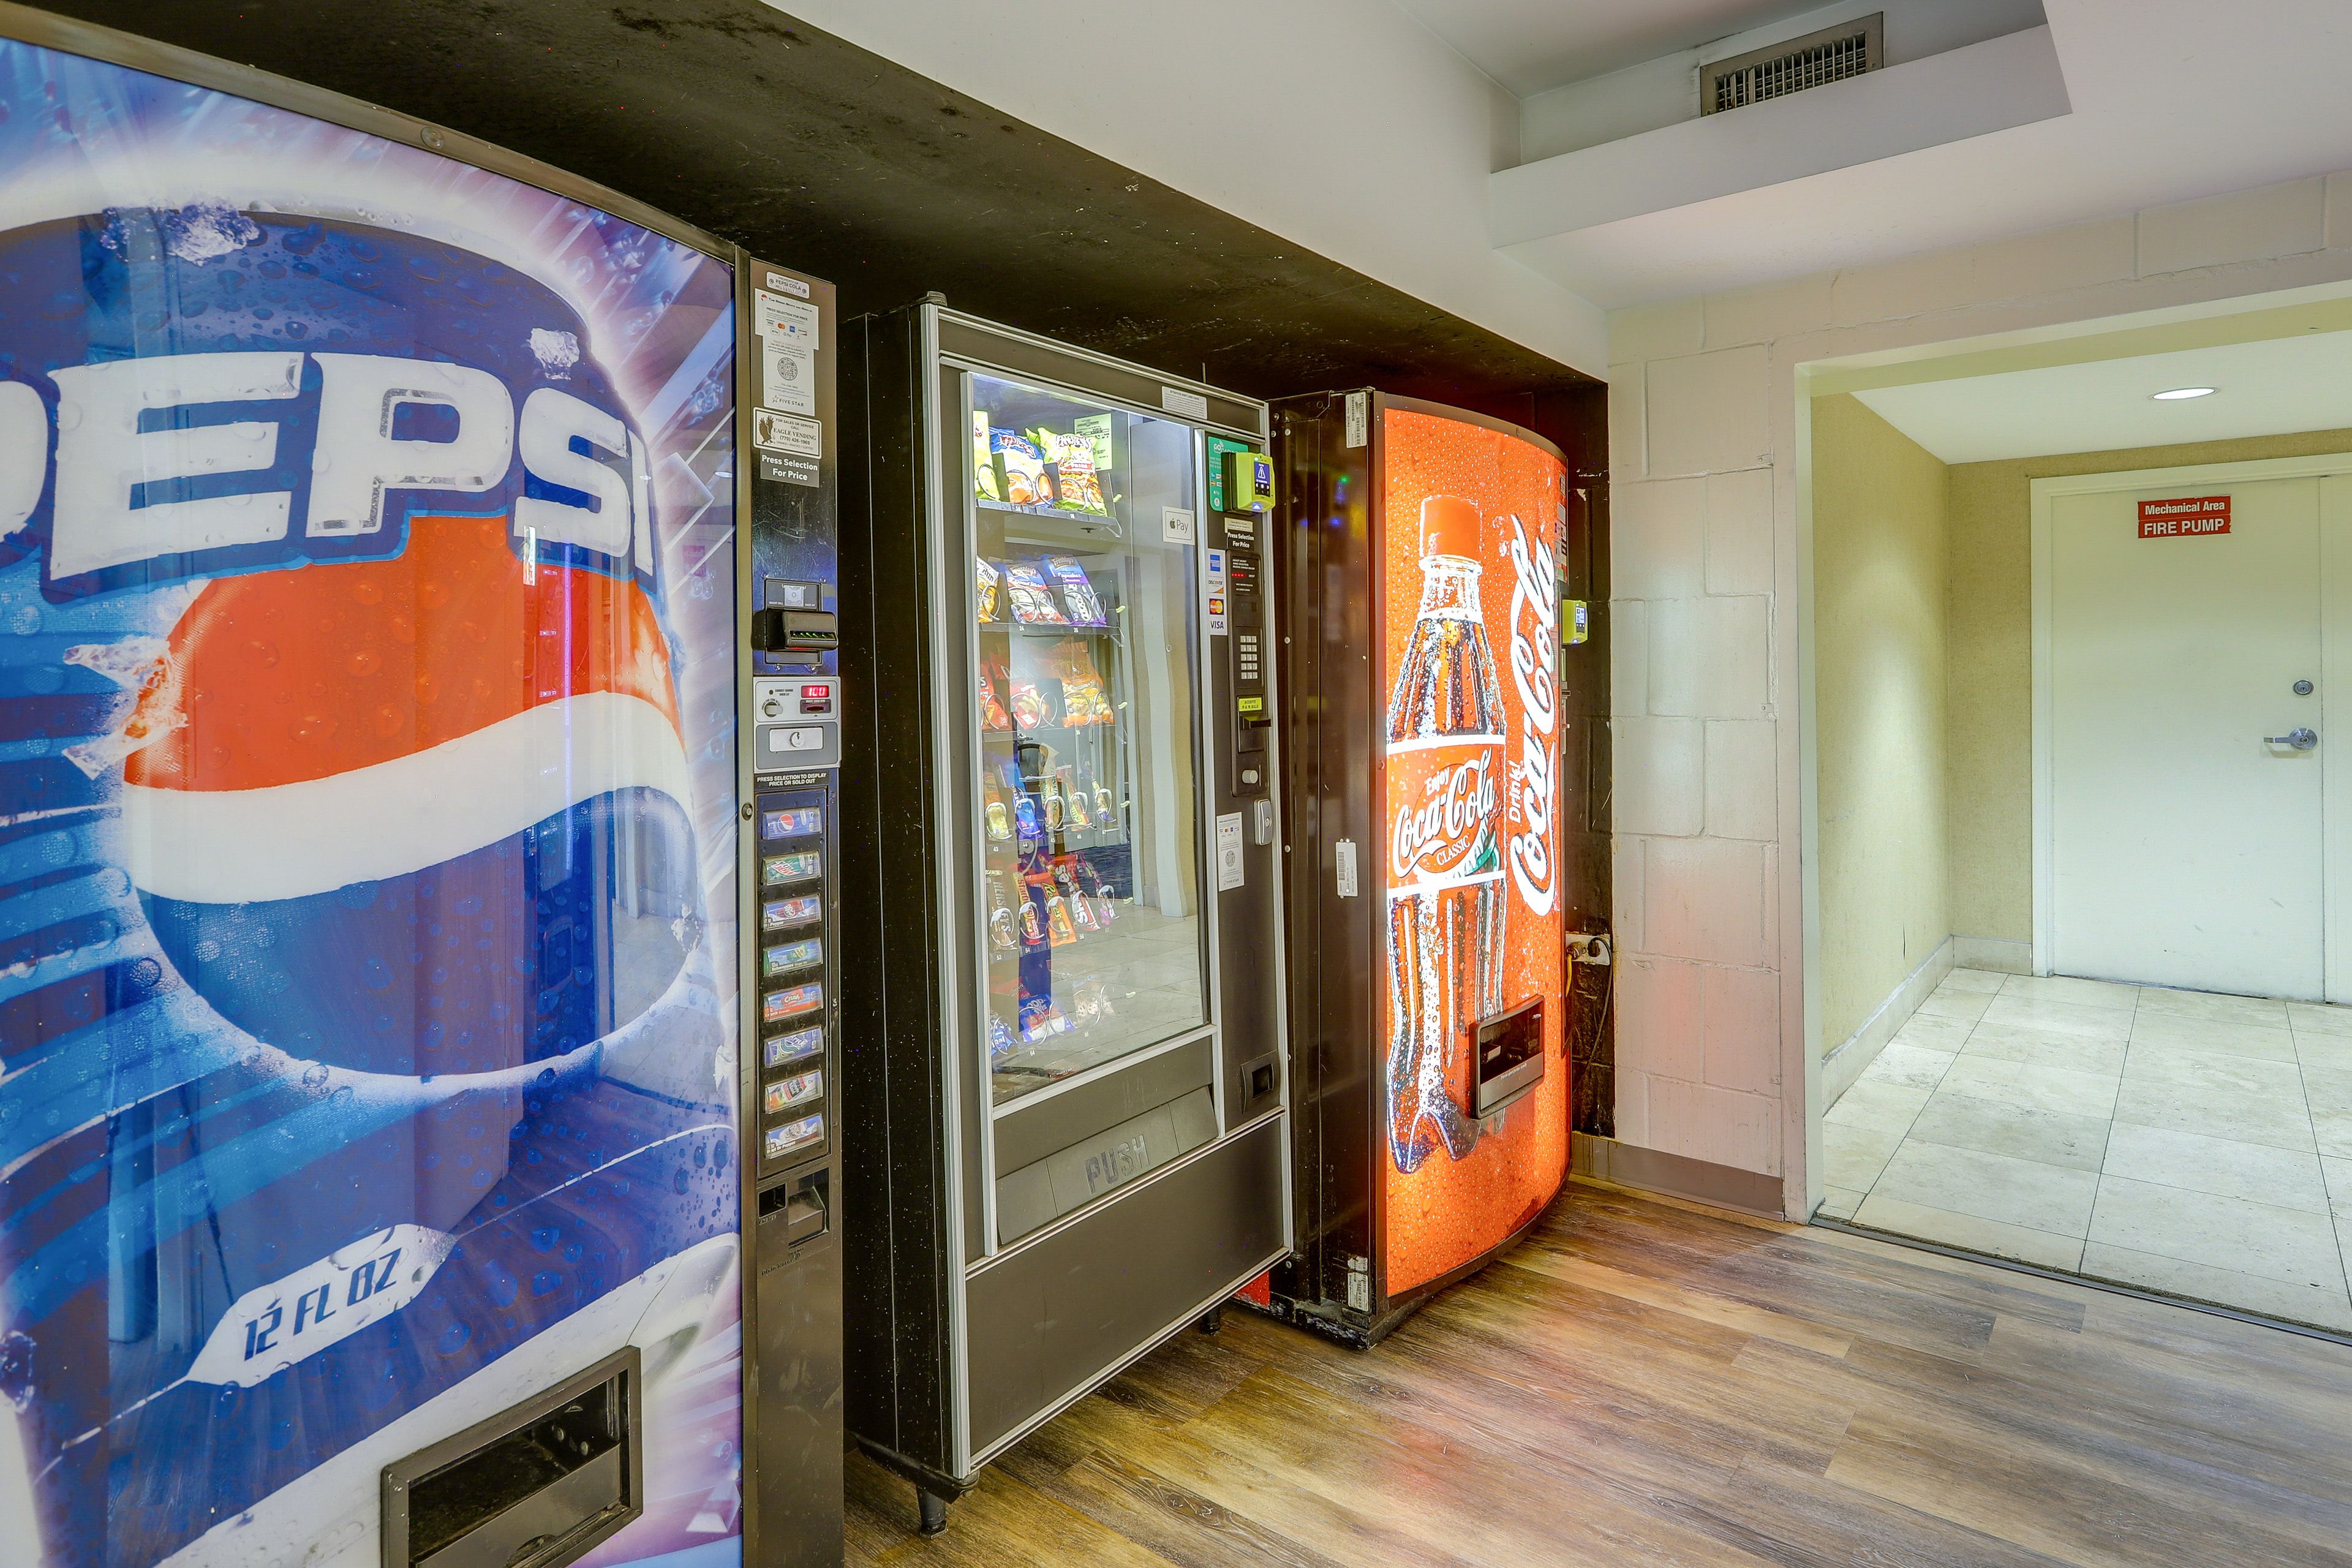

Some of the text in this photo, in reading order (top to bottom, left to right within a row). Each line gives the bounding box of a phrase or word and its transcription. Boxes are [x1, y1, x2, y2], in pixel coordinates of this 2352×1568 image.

[792, 431, 816, 440] VENDING
[0, 352, 654, 581] EPSI
[761, 454, 818, 471] Press Selection
[772, 468, 808, 481] For Price
[2145, 501, 2225, 515] Mechanical Area
[1177, 519, 1188, 533] Pay
[2144, 518, 2225, 535] FIRE PUMP
[1426, 767, 1450, 796] Enjoy
[1393, 746, 1495, 878] Coca-Cola
[1436, 835, 1471, 865] CLASSIC
[993, 881, 1011, 932] HERSEY'S
[1041, 882, 1063, 919] Ree's
[1085, 1134, 1150, 1193] PUSH
[244, 1247, 402, 1362] 12 FL OZ
